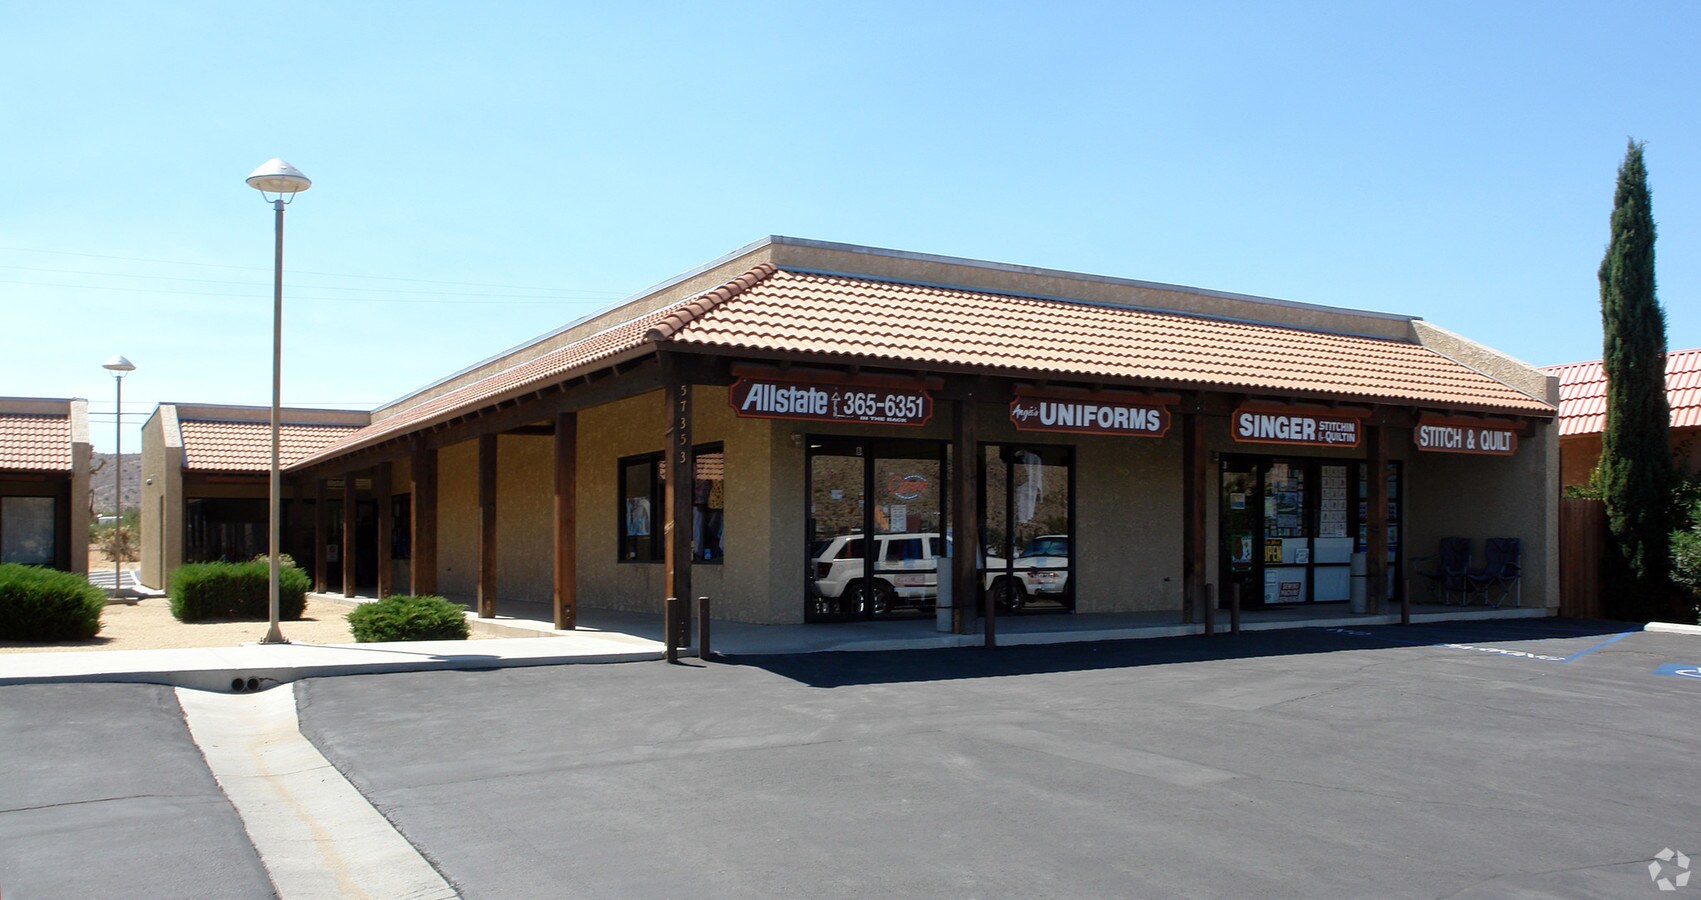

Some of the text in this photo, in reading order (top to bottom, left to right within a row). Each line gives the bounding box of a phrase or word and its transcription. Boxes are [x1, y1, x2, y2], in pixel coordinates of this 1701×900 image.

[741, 384, 828, 415] Allstate
[843, 392, 923, 418] 365-6351
[1040, 402, 1160, 431] UNIFORMS
[1240, 413, 1316, 440] SINGER
[1319, 421, 1355, 432] STITCHIN
[1325, 431, 1356, 443] QUILTIN
[1420, 425, 1512, 451] STITCH & QUILT
